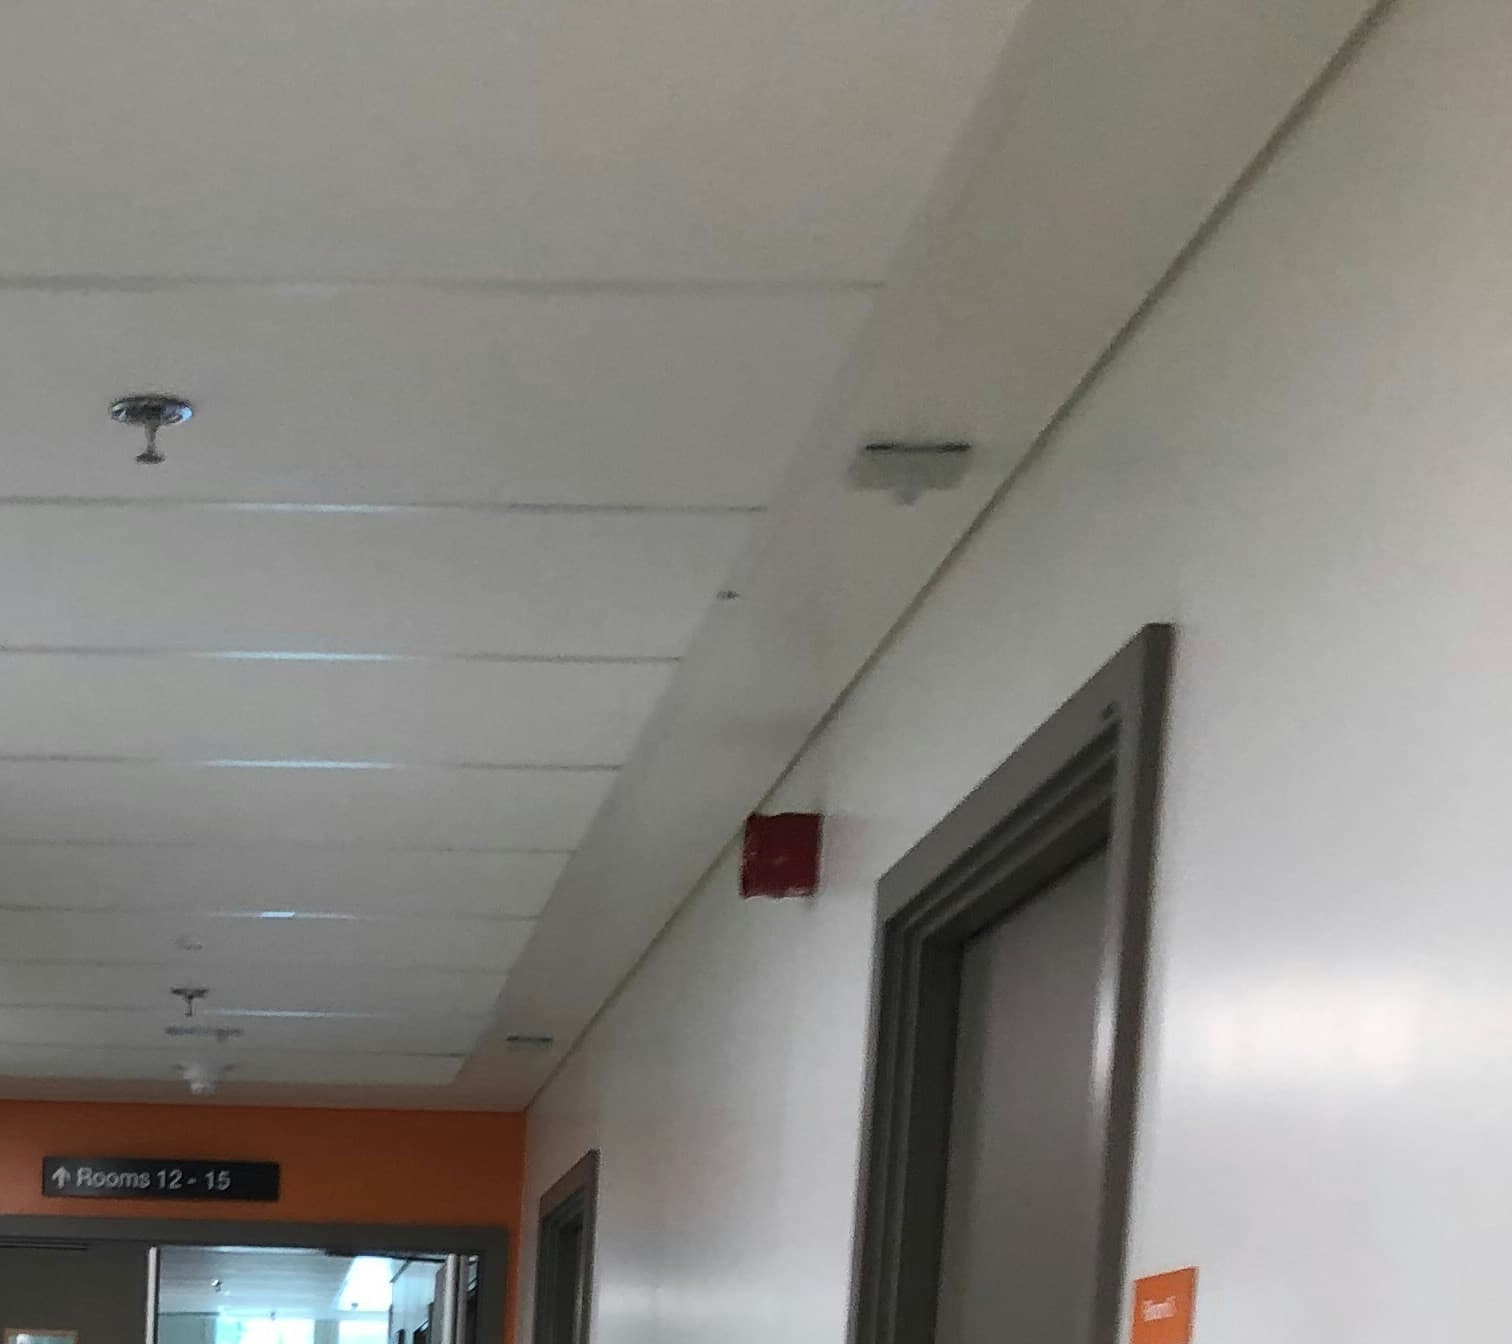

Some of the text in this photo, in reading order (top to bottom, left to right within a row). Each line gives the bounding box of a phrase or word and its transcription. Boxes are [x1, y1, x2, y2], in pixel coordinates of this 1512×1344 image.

[76, 1166, 151, 1189] Rooms
[157, 1168, 182, 1190] 12
[204, 1170, 232, 1191] 15
